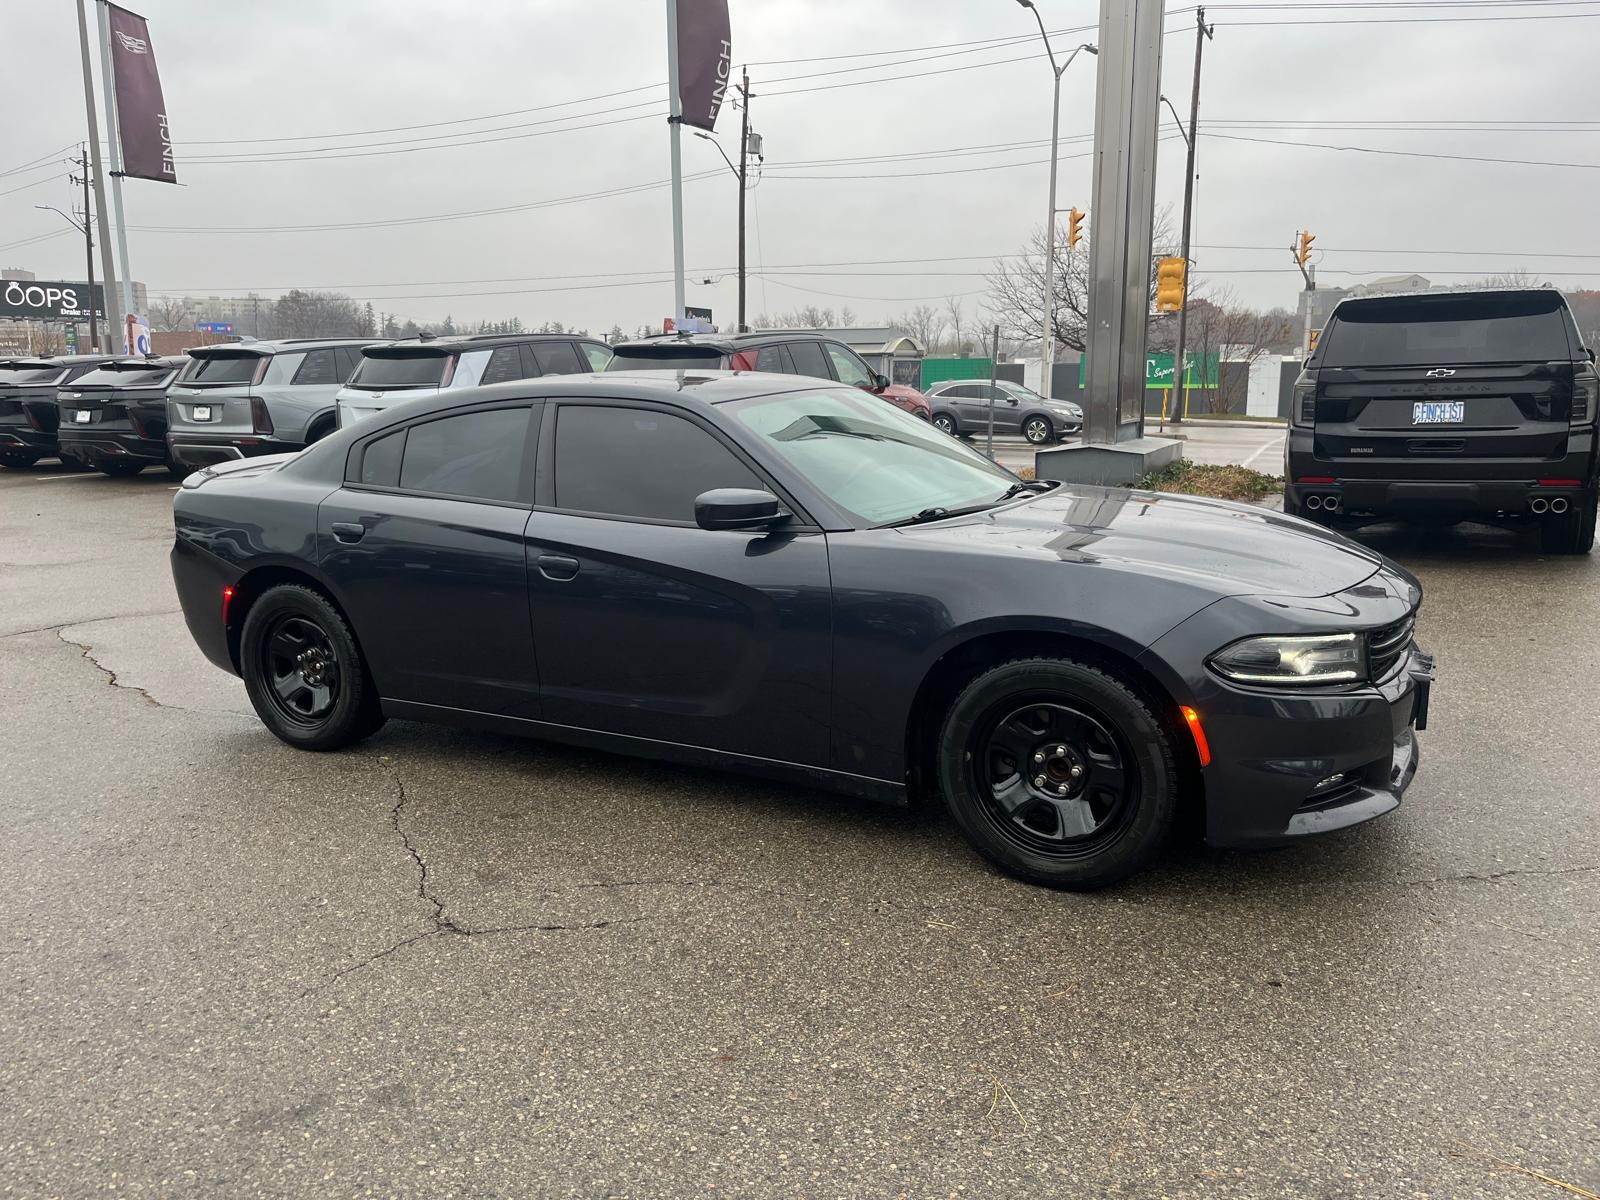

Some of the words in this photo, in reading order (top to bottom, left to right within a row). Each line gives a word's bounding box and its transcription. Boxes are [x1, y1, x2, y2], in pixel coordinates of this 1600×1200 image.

[709, 40, 731, 119] FINCH
[157, 114, 175, 174] FINCH
[5, 282, 78, 309] OOPS
[60, 308, 81, 316] Drake
